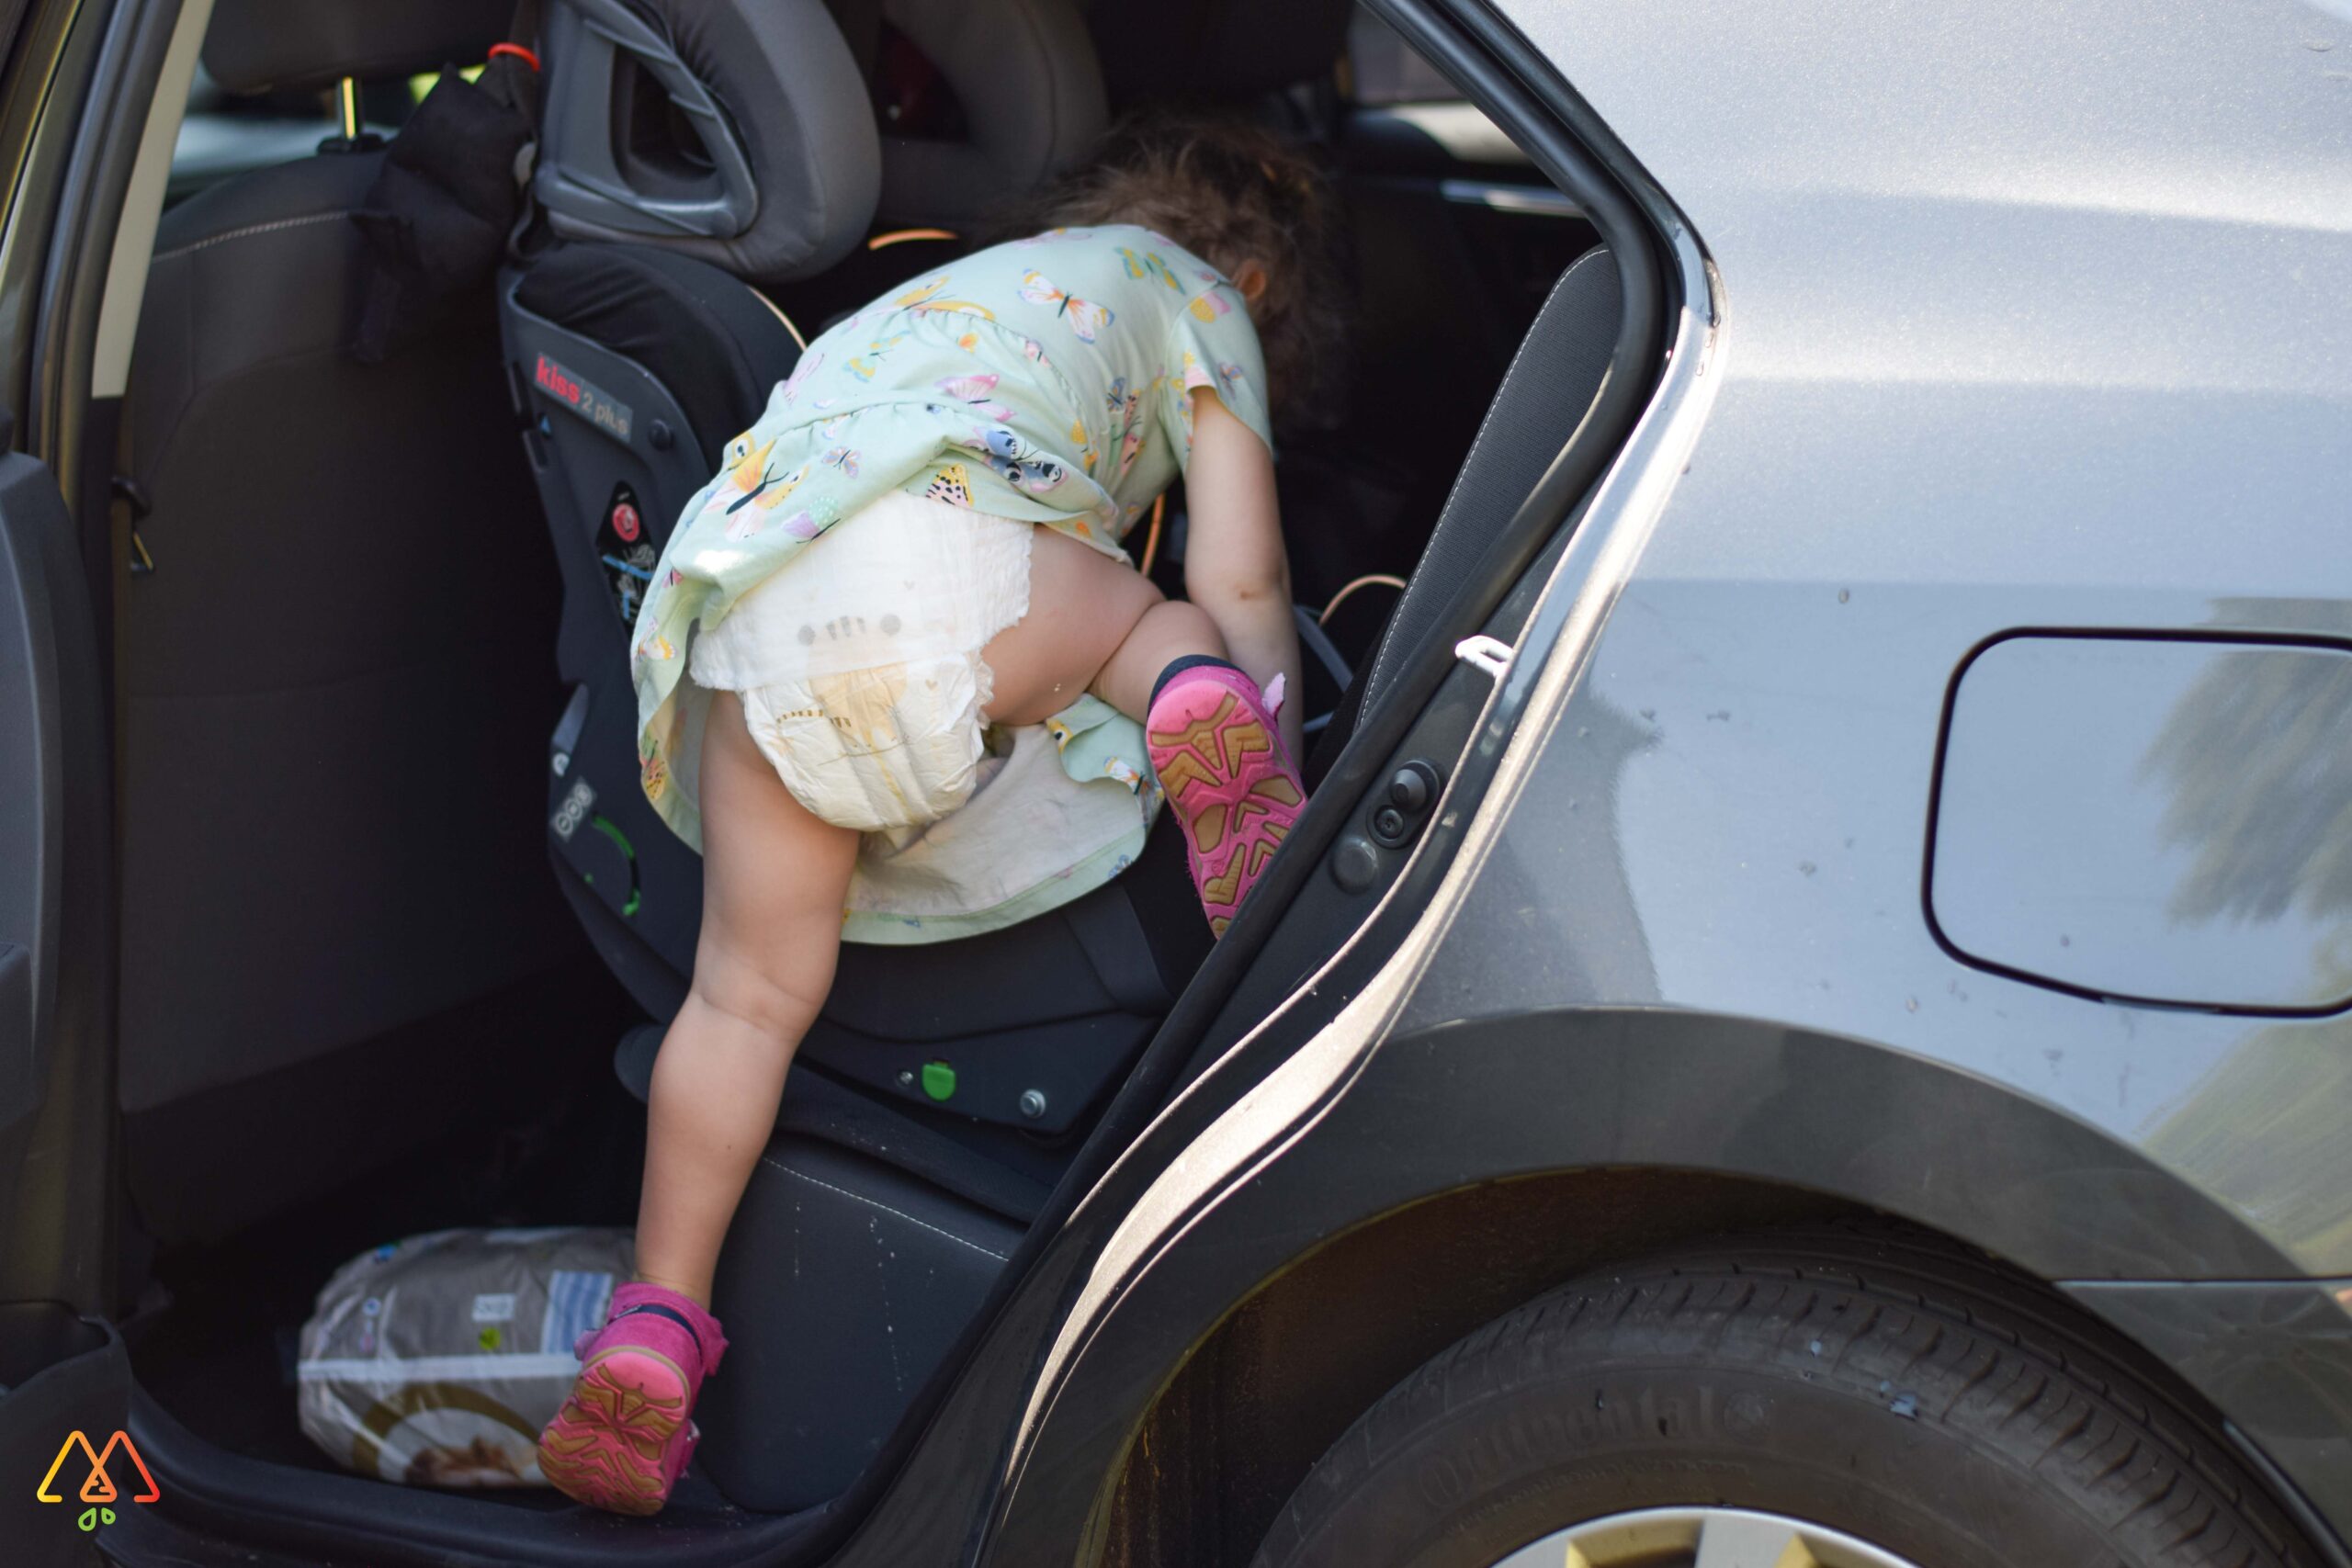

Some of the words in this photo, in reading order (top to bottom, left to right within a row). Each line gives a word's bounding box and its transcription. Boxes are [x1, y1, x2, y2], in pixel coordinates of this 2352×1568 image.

[537, 355, 580, 404] kiss
[582, 391, 593, 412] 2
[594, 402, 628, 434] plus
